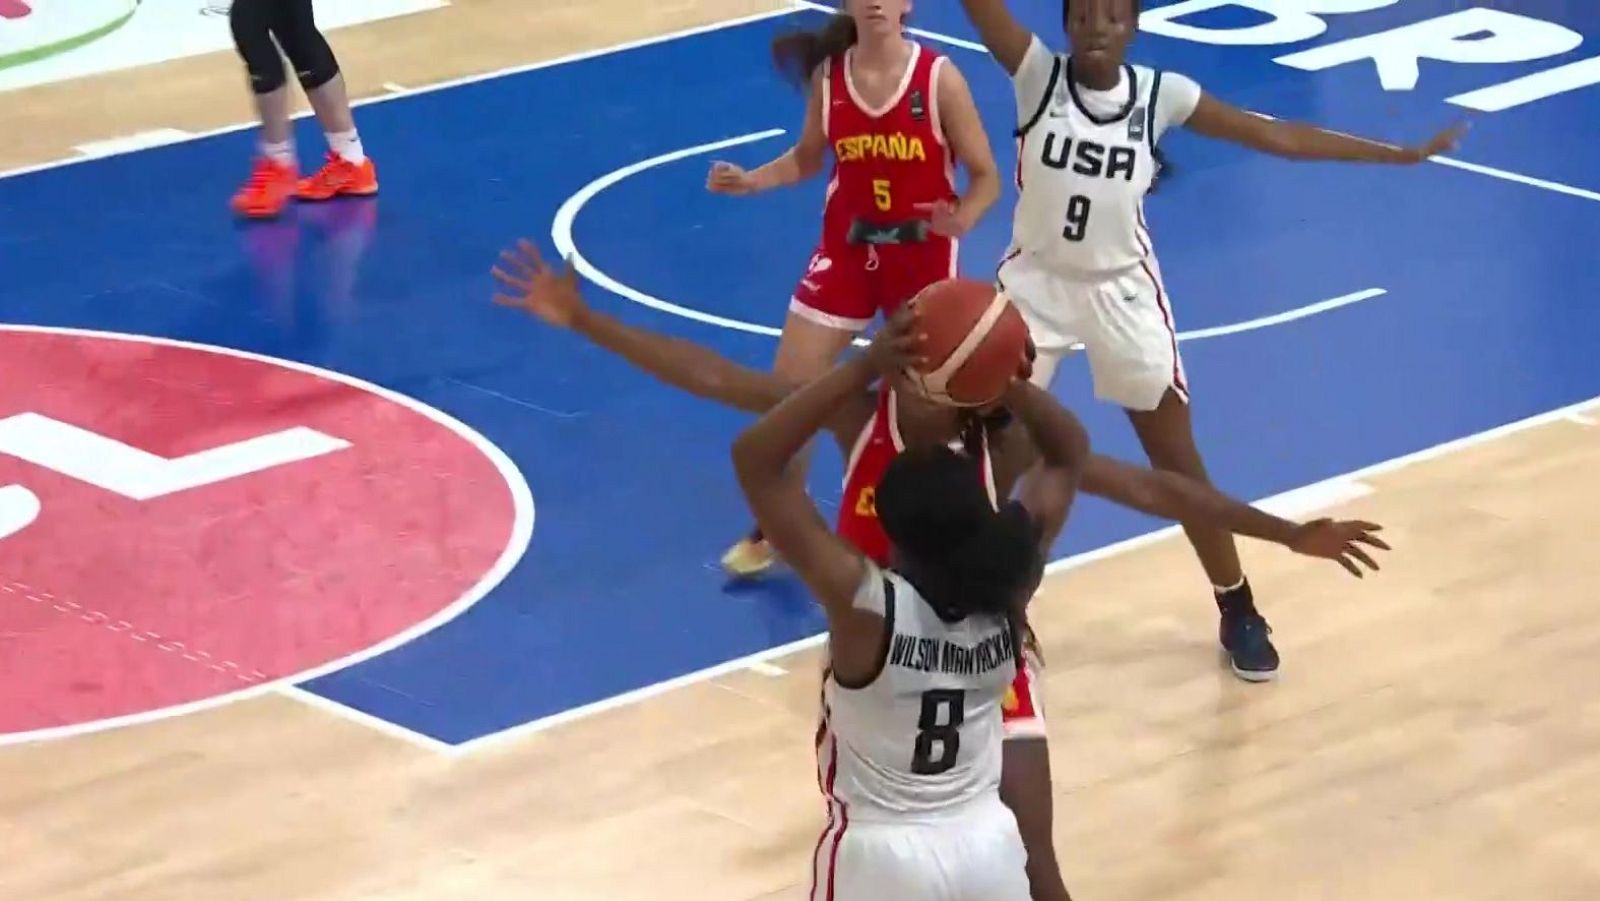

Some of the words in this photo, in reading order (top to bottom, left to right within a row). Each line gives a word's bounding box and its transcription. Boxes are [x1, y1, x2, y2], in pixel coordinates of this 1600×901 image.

[1041, 131, 1136, 181] USA
[872, 179, 892, 211] 5
[1062, 194, 1091, 242] 9
[889, 633, 940, 672] WILSON
[911, 689, 965, 775] 8
